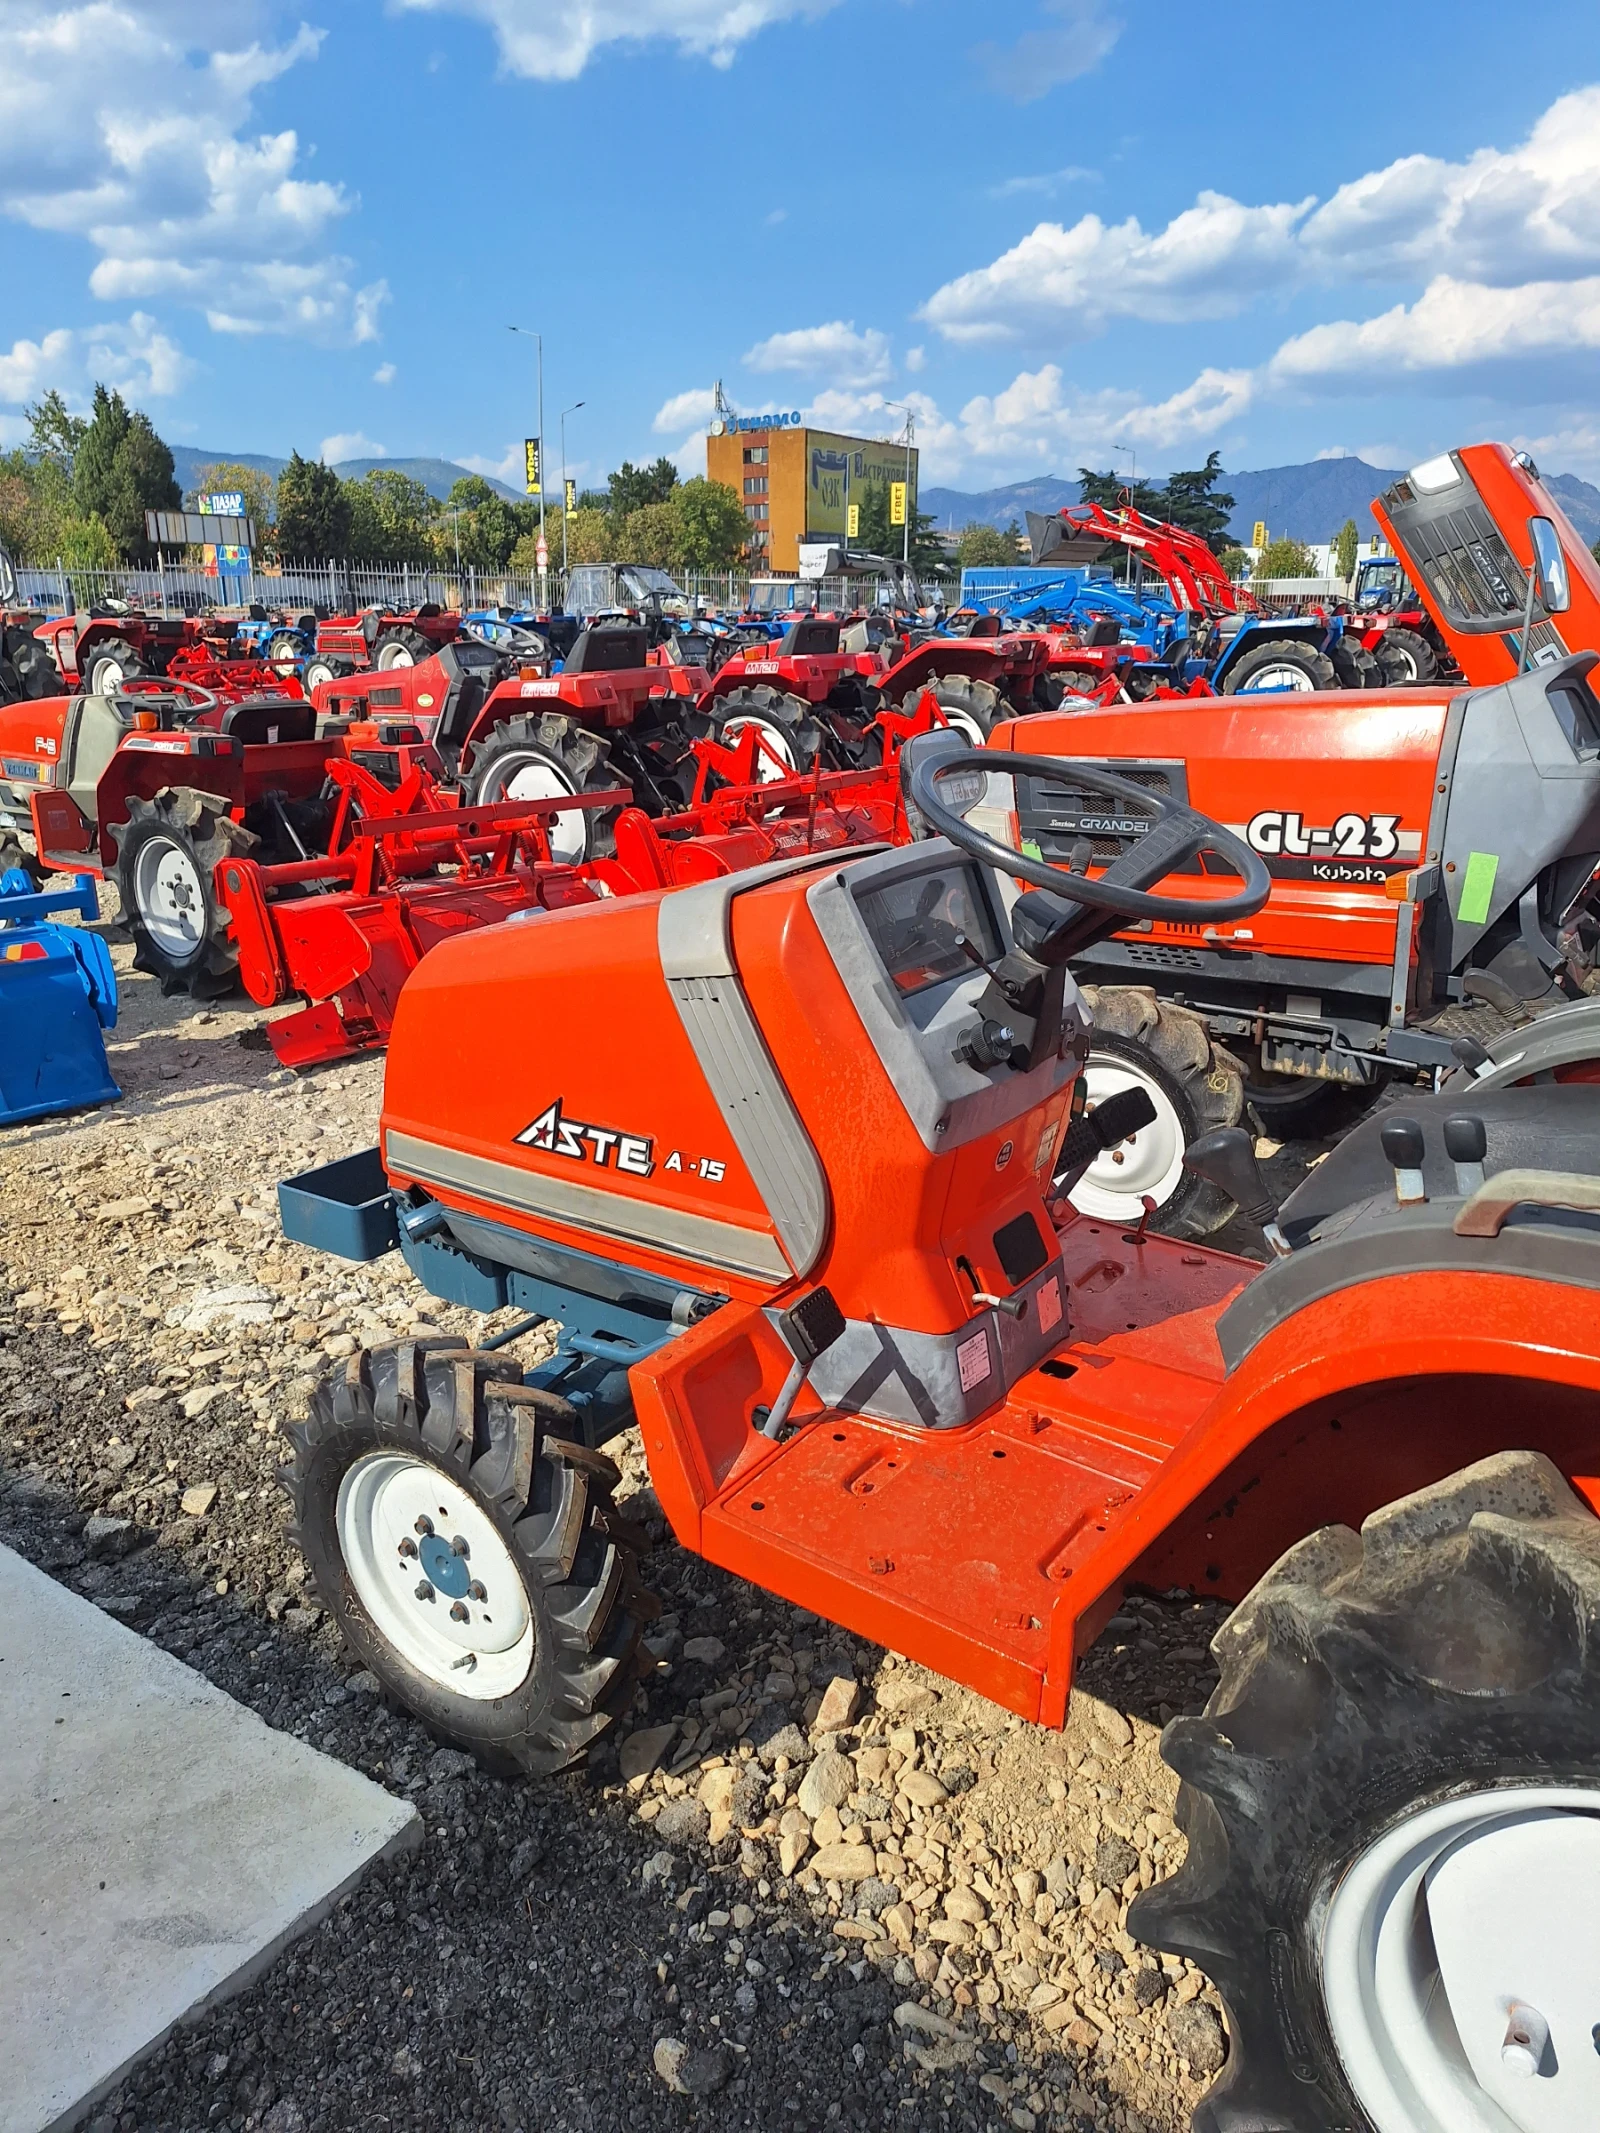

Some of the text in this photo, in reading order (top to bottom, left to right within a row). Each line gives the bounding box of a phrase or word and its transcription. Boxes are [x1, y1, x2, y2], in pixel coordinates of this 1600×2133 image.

[212, 494, 242, 509] ПАЗАР
[1049, 819, 1076, 828] Sunshine
[1248, 811, 1402, 858] GL-23
[1312, 864, 1387, 882] Kubota
[513, 1098, 655, 1176] ASTE
